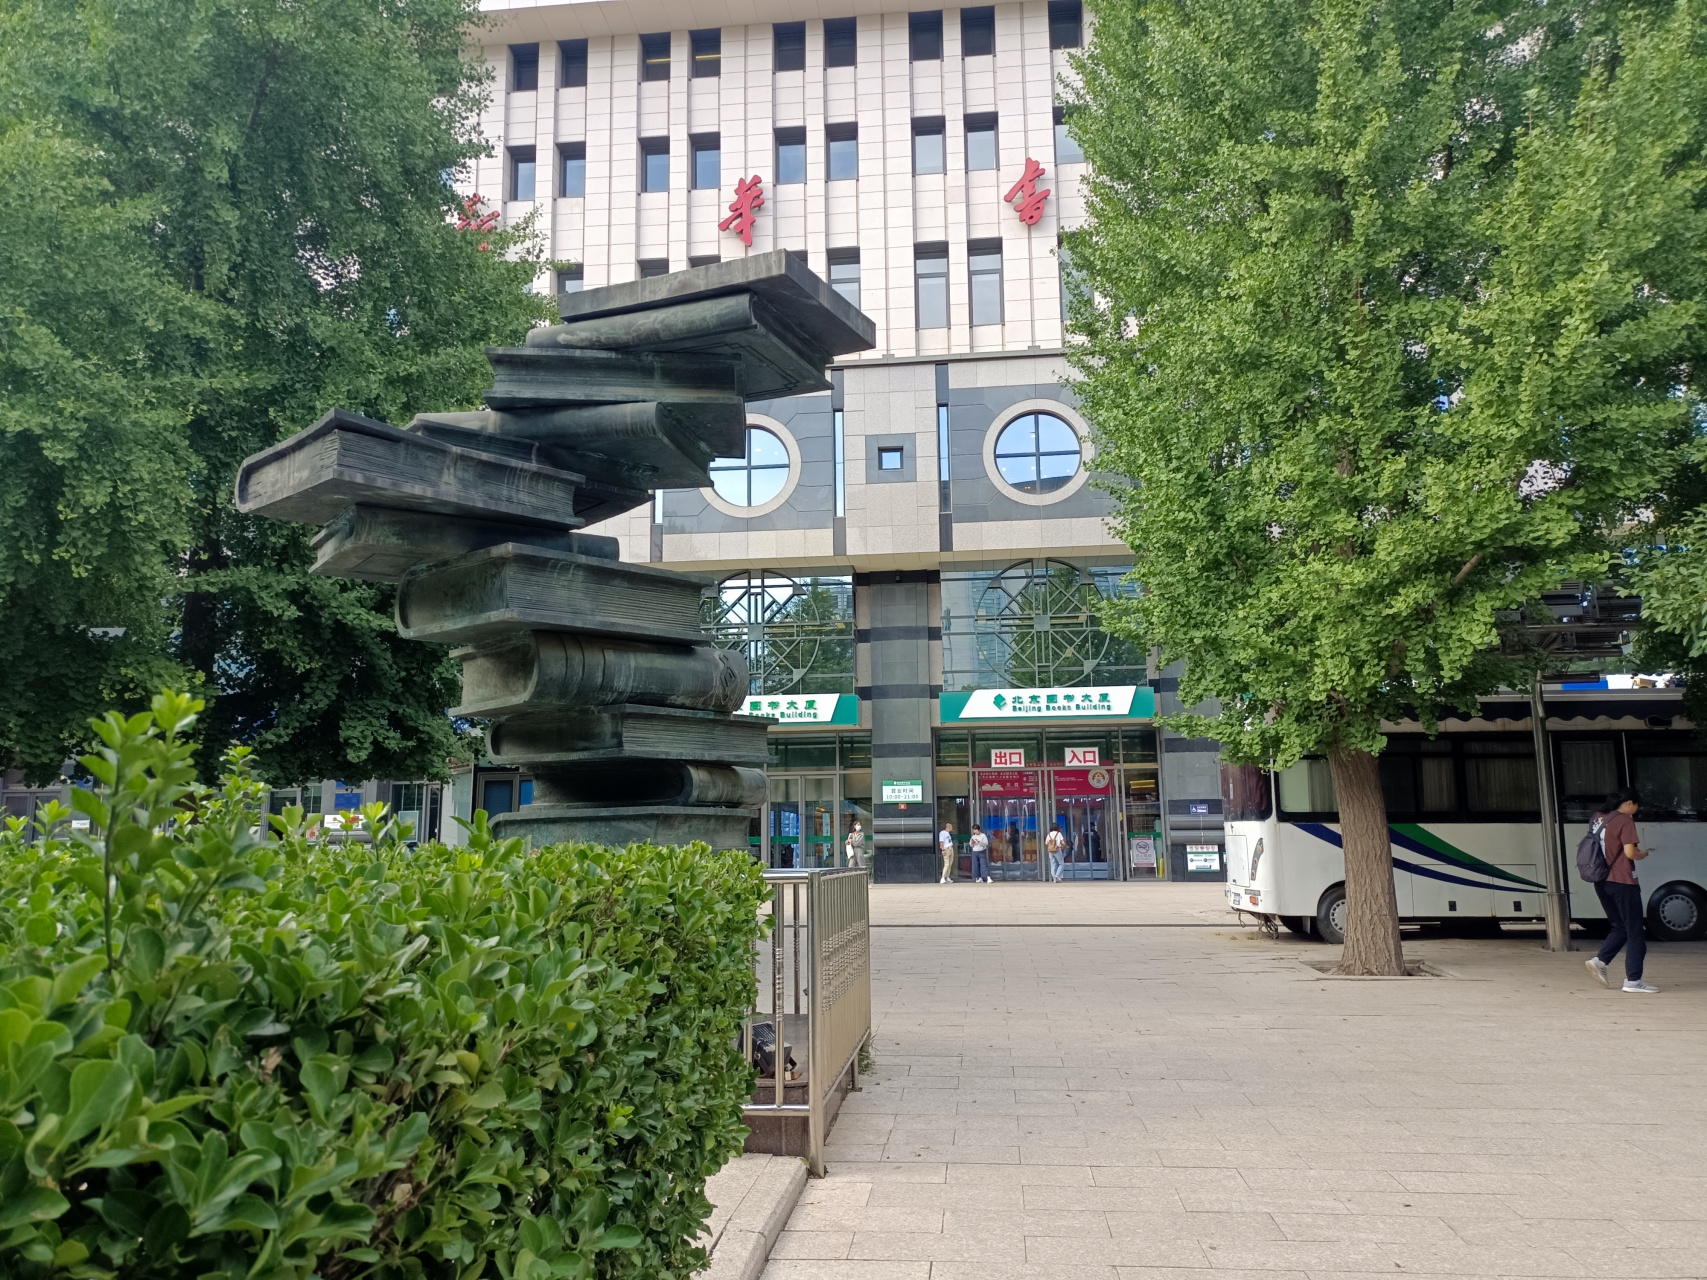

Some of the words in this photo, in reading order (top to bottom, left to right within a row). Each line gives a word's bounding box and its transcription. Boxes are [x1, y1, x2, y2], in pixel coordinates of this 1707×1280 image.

[1012, 693, 1111, 704] 北京图书大厦
[739, 699, 817, 711] 图书大厦
[1076, 703, 1111, 711] Building
[780, 711, 818, 719] Building
[994, 751, 1022, 765] 出口
[1068, 750, 1097, 764] 入口
